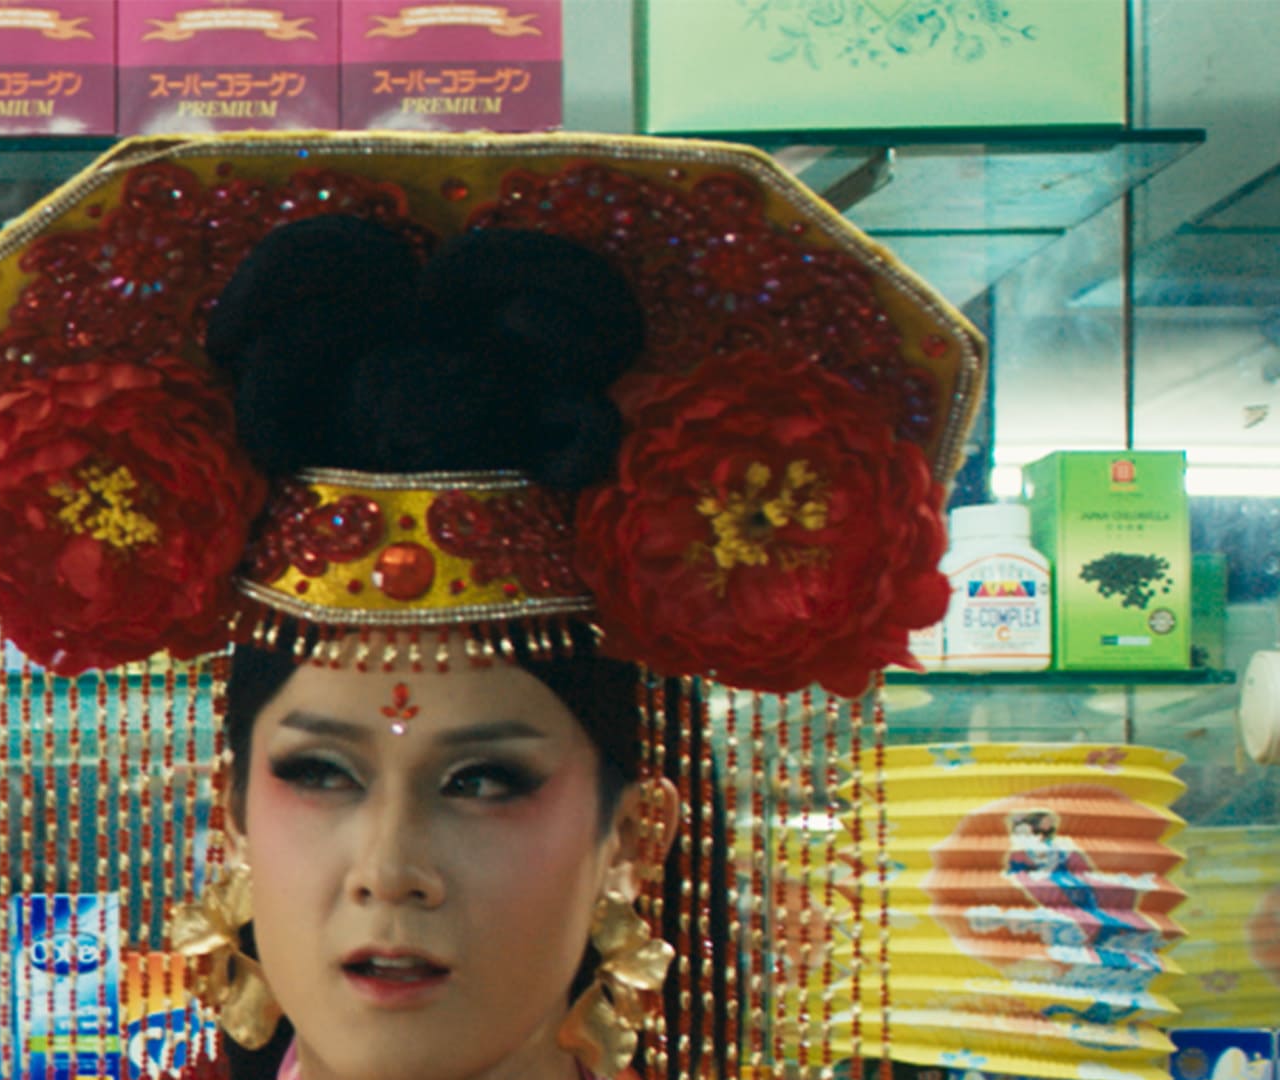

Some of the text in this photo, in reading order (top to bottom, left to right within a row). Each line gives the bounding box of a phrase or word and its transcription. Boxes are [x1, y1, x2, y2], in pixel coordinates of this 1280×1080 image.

[149, 72, 305, 98] スーパーコラーゲン
[373, 68, 530, 94] スーパーコラーゲン
[177, 100, 278, 118] PREMIUM
[401, 96, 502, 115] PREMIUM
[963, 607, 1040, 628] B-COMPLEX
